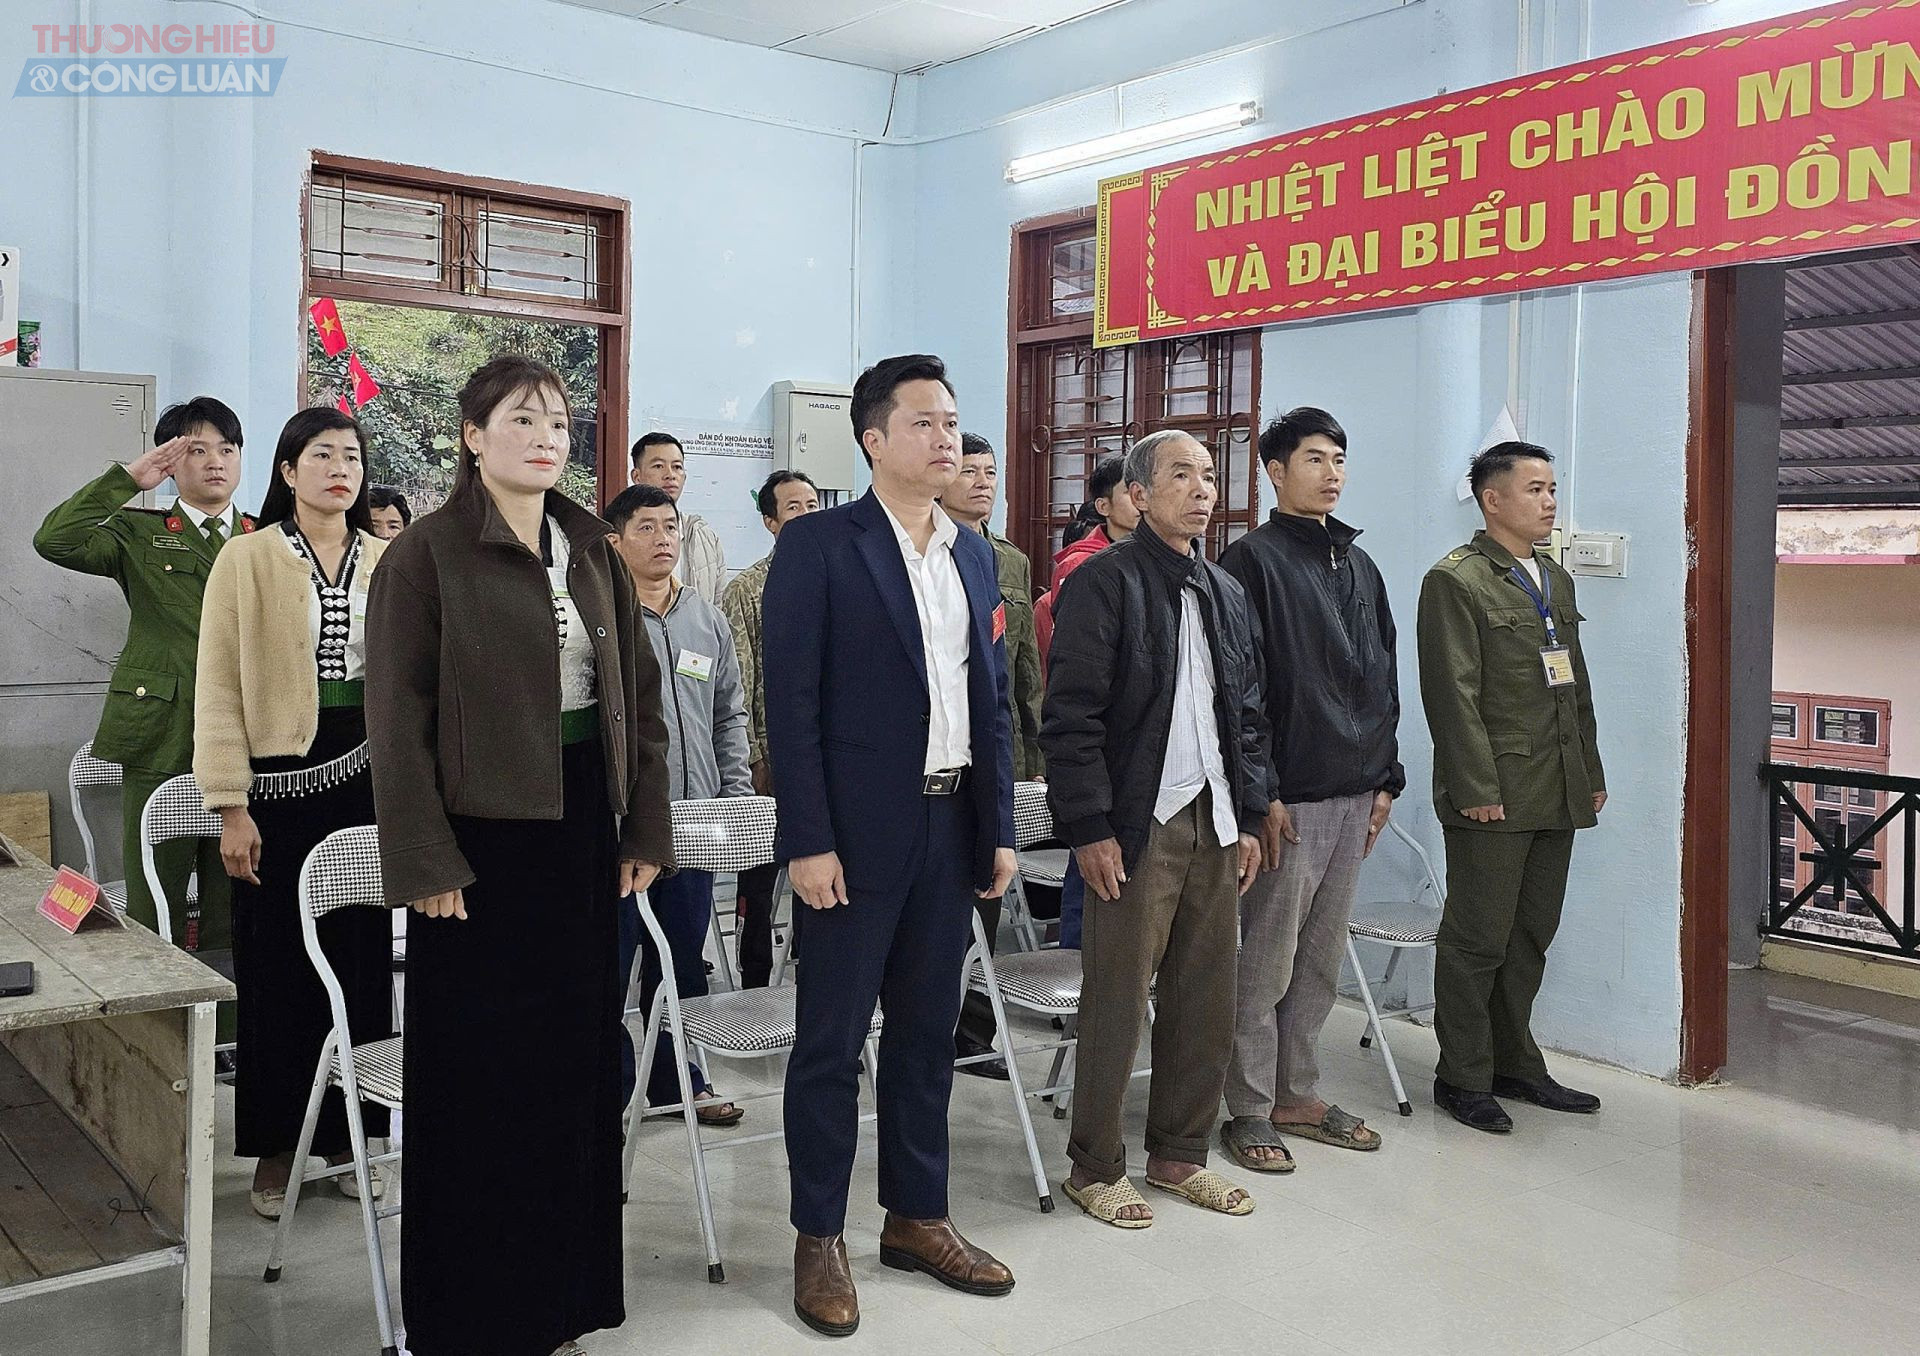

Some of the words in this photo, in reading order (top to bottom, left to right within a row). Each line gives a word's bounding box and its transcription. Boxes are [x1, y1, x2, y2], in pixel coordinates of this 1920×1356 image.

[1195, 161, 1345, 232] NHIỆT
[1363, 131, 1487, 199] LIỆT
[1509, 87, 1706, 169] CHÀO
[1207, 243, 1270, 297] VÀ
[1286, 230, 1380, 288] ĐẠI
[1401, 189, 1547, 269] BIỂU
[1572, 172, 1697, 245] HỘI
